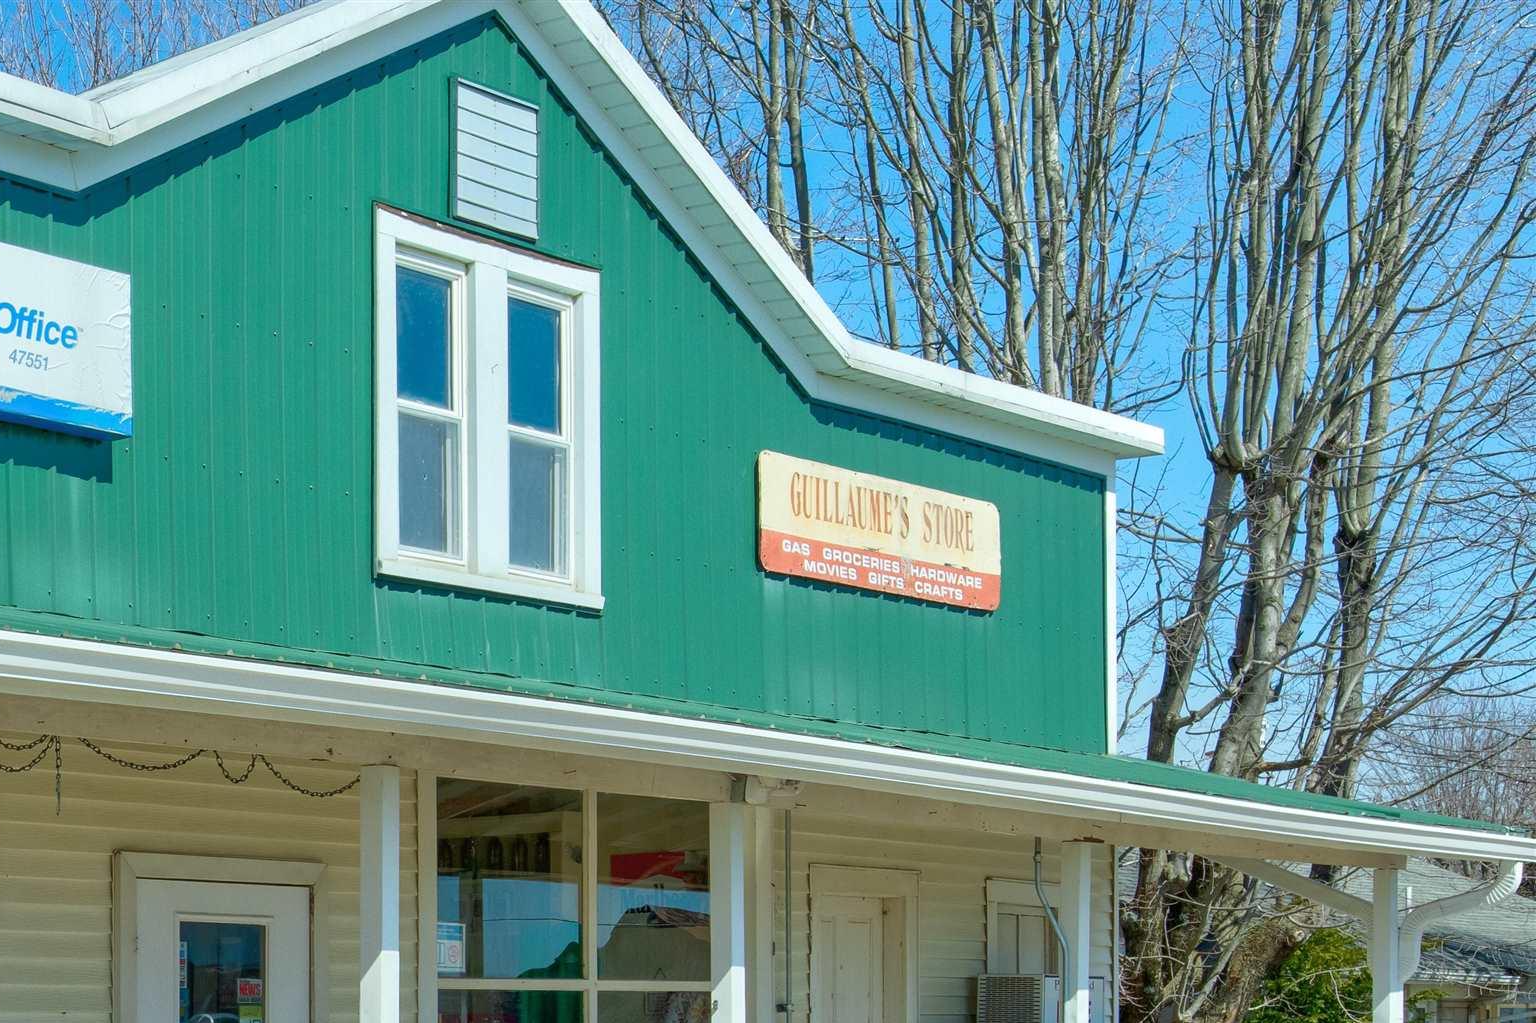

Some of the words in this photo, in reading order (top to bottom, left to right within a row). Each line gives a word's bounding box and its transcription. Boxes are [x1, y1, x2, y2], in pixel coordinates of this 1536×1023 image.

[8, 349, 49, 371] 47551
[790, 471, 910, 540] GUILLAUME'S
[922, 501, 975, 555] STORE
[782, 539, 811, 556] GAS
[823, 548, 900, 574] GROCERIES
[910, 566, 983, 589] HARDWARE
[804, 560, 857, 581] MOVIES
[868, 572, 905, 589] GIFTS
[914, 581, 963, 601] CRAFTS
